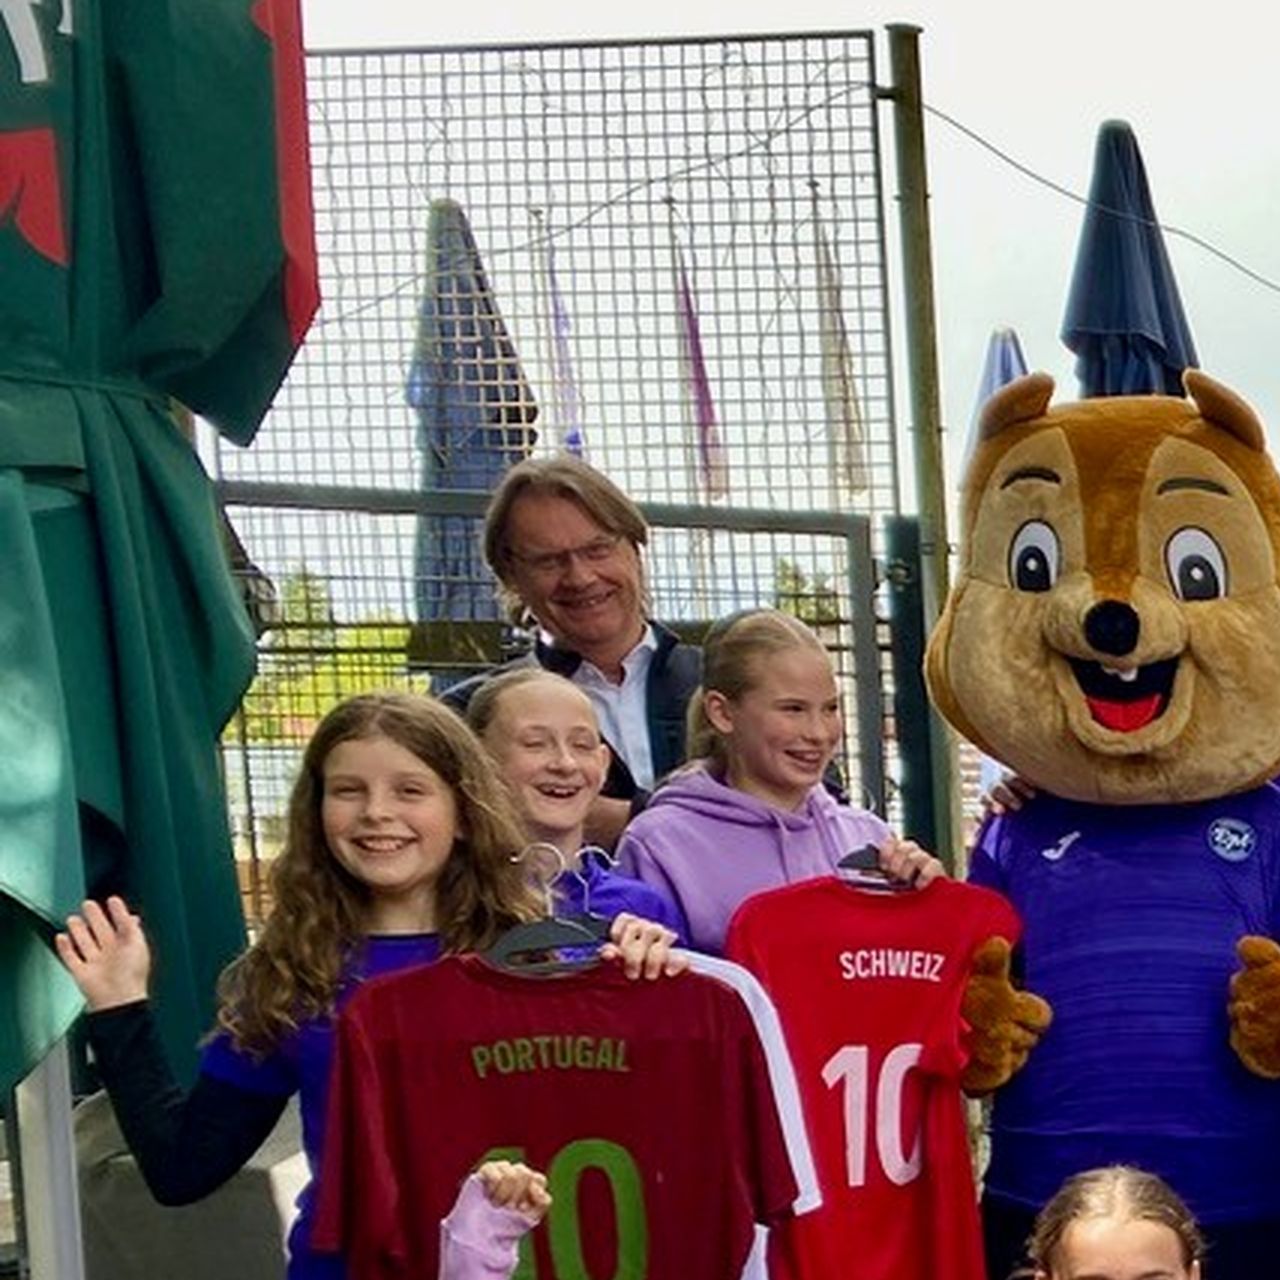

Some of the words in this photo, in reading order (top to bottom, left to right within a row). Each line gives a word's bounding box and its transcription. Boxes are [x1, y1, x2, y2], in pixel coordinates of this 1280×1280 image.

[839, 949, 945, 983] SCHWEIZ
[472, 1035, 629, 1078] PORTUGAL
[821, 1043, 924, 1187] 10
